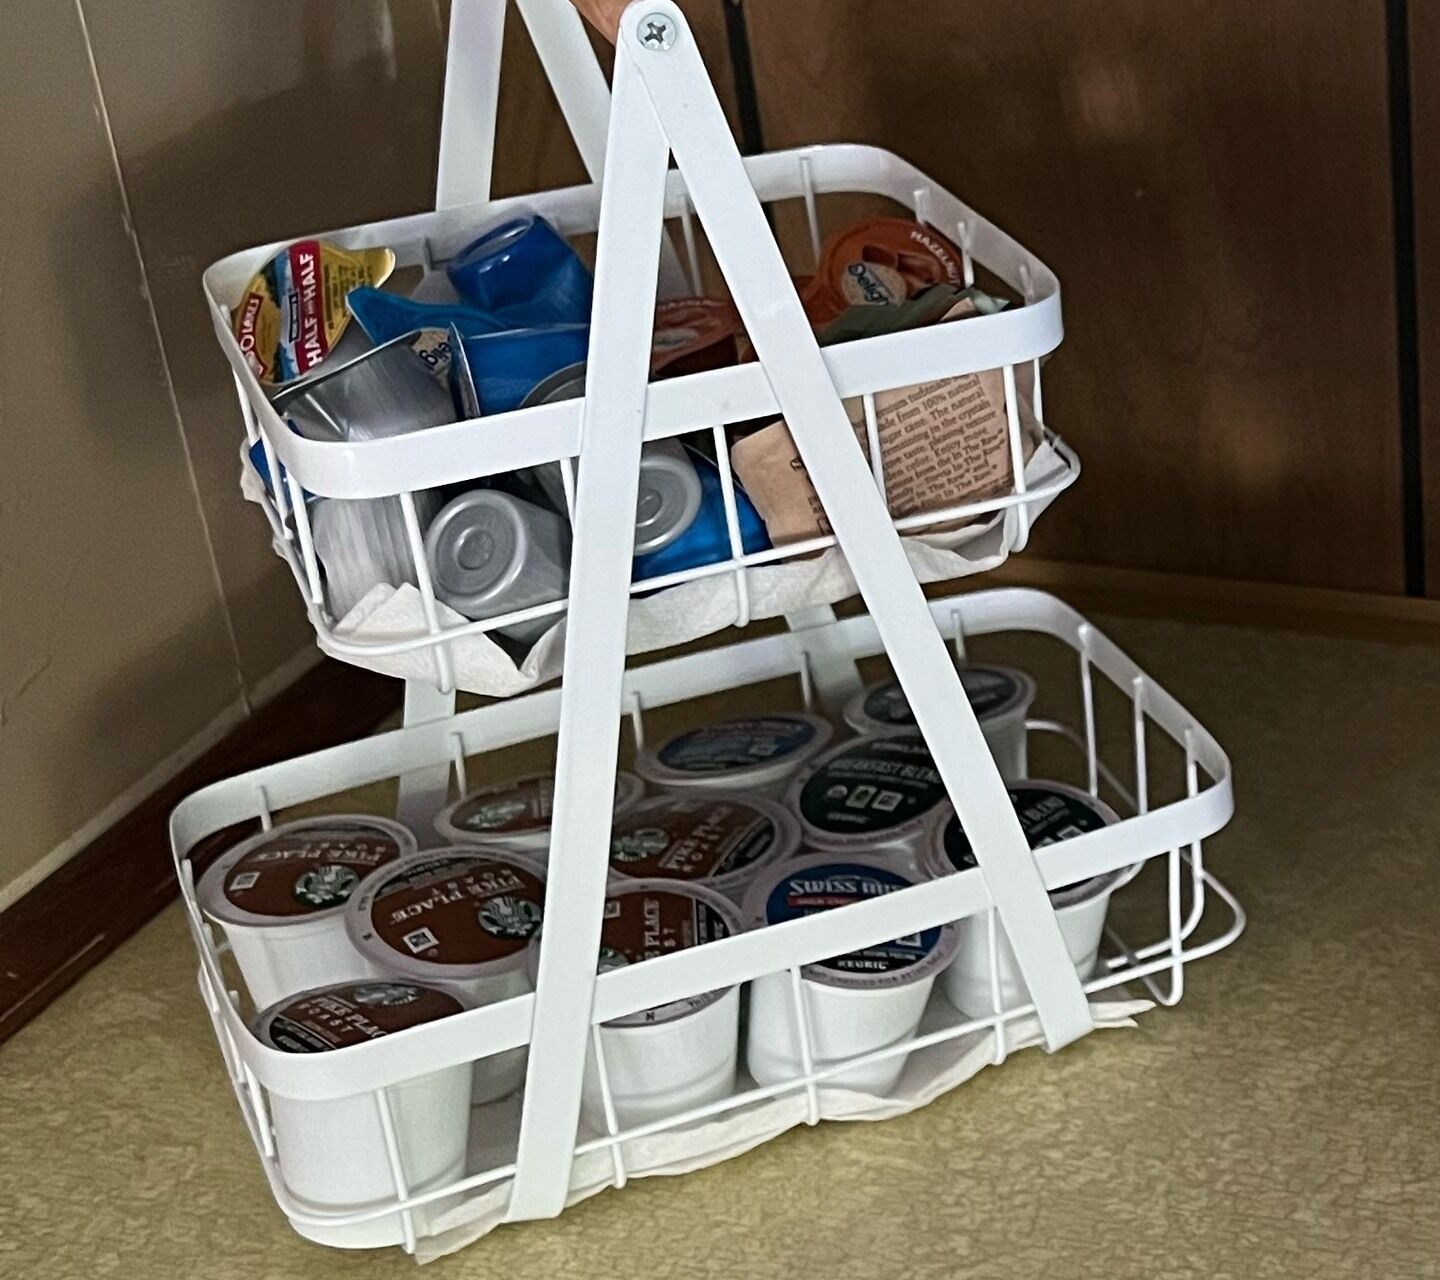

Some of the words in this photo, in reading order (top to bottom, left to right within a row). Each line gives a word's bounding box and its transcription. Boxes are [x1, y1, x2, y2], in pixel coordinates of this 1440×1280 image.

[299, 252, 317, 302] HALF
[303, 316, 324, 368] HALF
[929, 407, 949, 420] The
